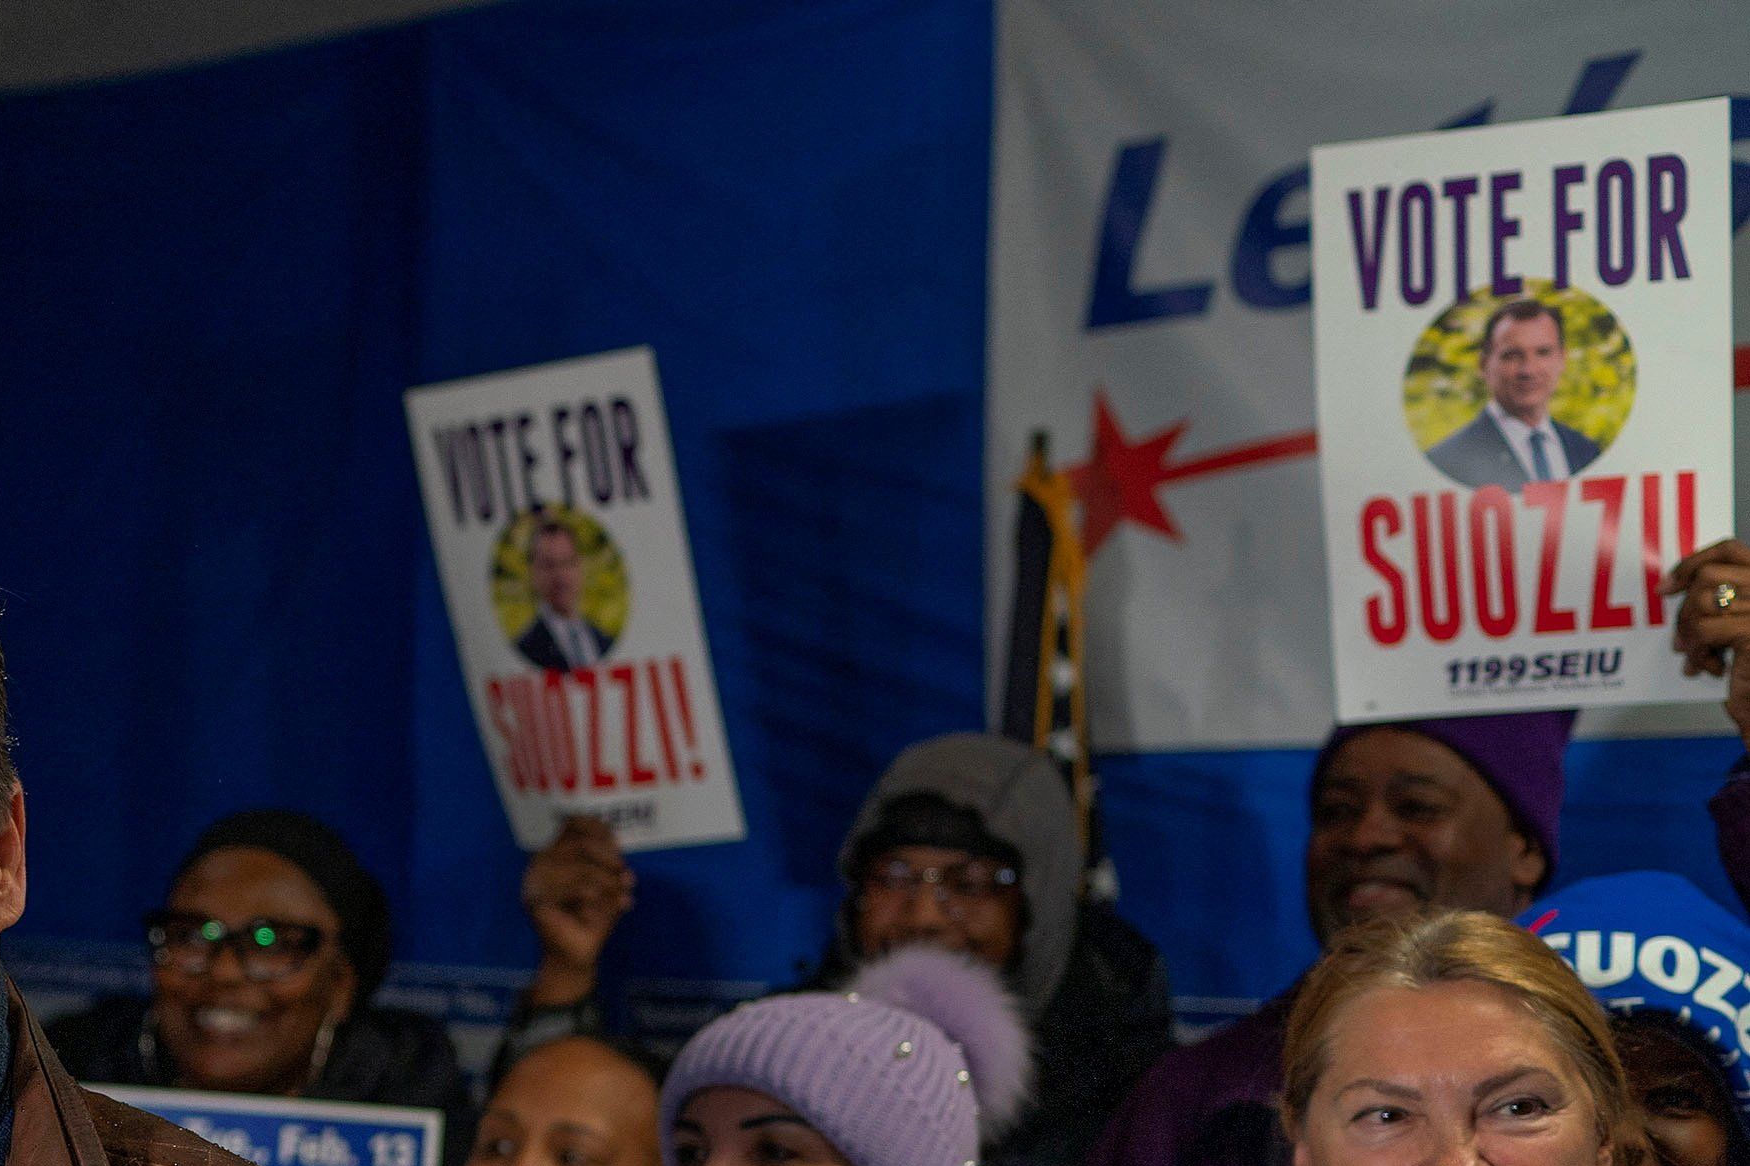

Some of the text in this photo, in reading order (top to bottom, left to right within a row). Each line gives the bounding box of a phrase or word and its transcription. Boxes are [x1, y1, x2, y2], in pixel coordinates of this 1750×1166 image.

[1347, 170, 1524, 310] VOTE
[1553, 154, 1691, 291] FOR
[433, 398, 651, 525] VOTE FOR
[1359, 470, 1698, 647] SUOZZI!
[488, 657, 704, 792] SUOZZI!
[1446, 647, 1623, 686] 1199SEIU
[1543, 930, 1750, 1060] UOZ
